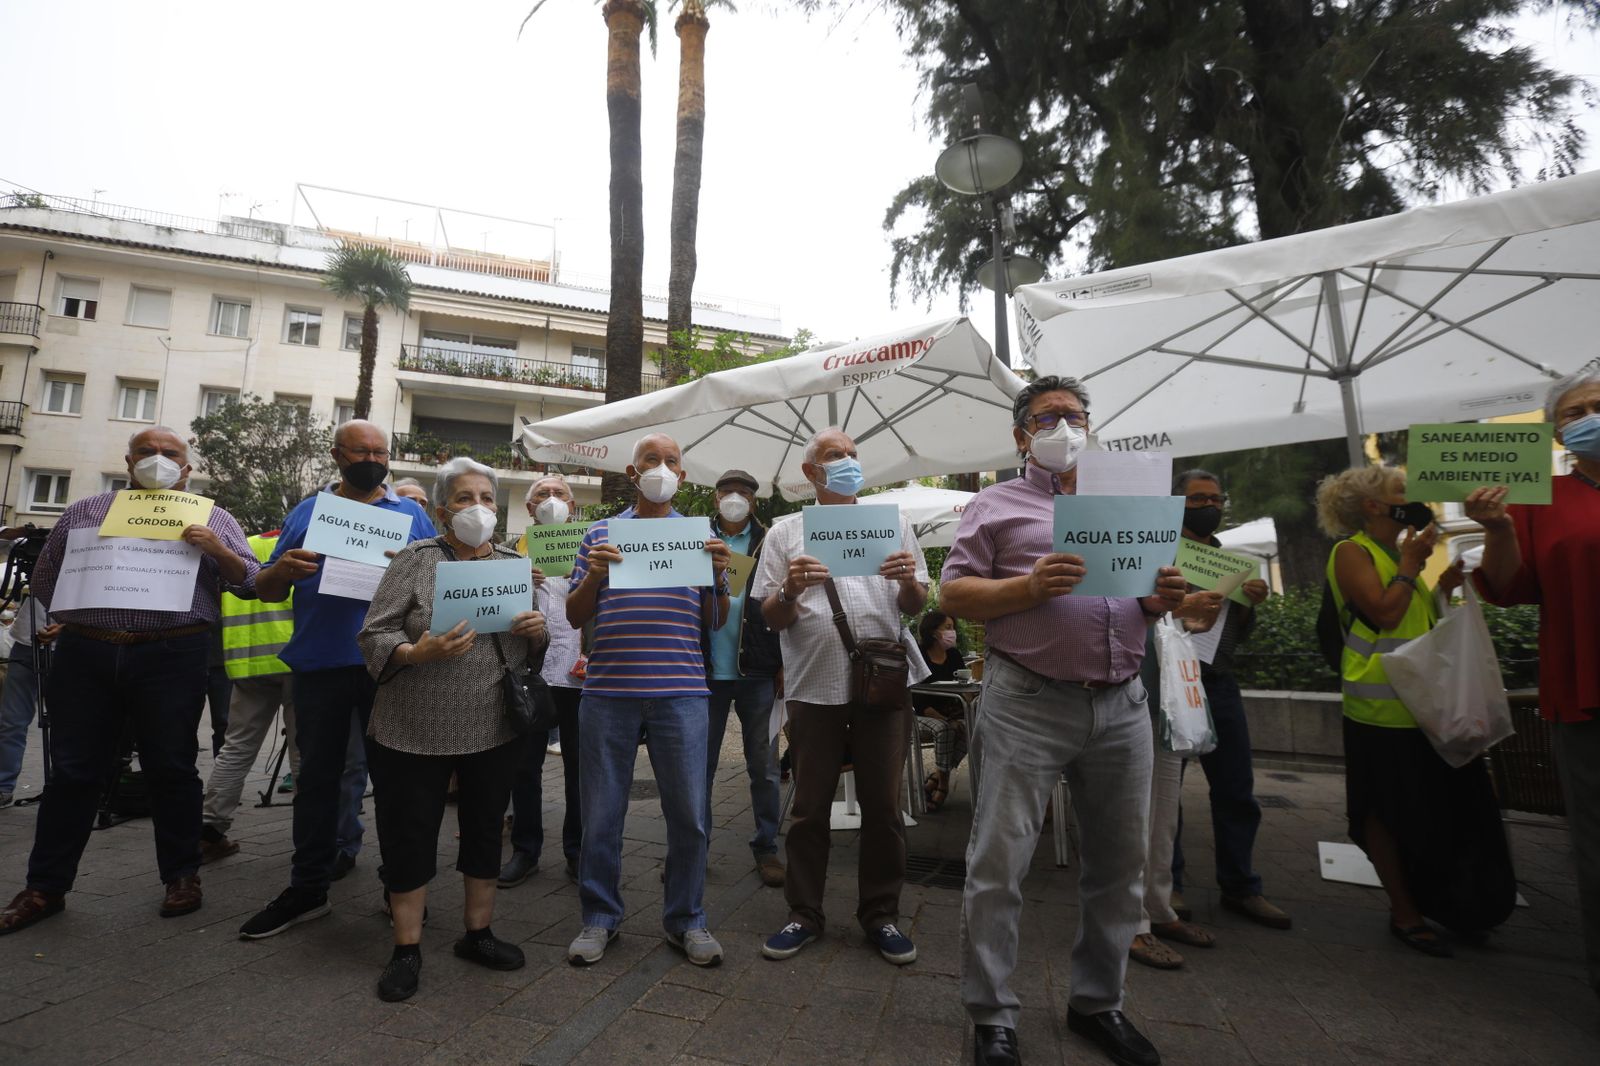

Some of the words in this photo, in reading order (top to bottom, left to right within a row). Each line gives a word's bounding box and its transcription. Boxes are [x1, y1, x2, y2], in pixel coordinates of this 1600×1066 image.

[823, 336, 935, 371] Cruzcampo
[1421, 432, 1540, 444] SANEAMIENTO
[1441, 452, 1458, 462] ES
[1462, 452, 1518, 463] MEDIO
[1418, 471, 1500, 482] AMBIENTE
[1506, 472, 1539, 484] ¡YA!
[145, 494, 199, 506] PERIFERIA
[127, 517, 184, 527] CÓRDOBA
[318, 513, 350, 528] AGUA
[353, 522, 366, 532] ES
[368, 526, 403, 541] SALUD
[533, 528, 588, 539] SANEAMIENT
[810, 531, 842, 541] AGUA
[846, 530, 858, 540] ES
[861, 529, 894, 539] SALUD
[1064, 531, 1112, 544] AGUA
[1117, 531, 1133, 544] ES
[1137, 530, 1177, 544] SALUD
[346, 536, 369, 549] ¡YA!
[545, 543, 555, 551] ES
[558, 542, 582, 550] MEDI
[616, 543, 649, 552] AGUA
[652, 542, 664, 551] ES
[668, 541, 704, 551] SALUD
[843, 548, 865, 559] ¡YA!
[1185, 543, 1252, 568] SANEAMIENTO
[650, 559, 672, 571] ¡YA!
[1111, 557, 1142, 572] ¡YA!
[1182, 561, 1224, 579] AMBIEN
[1208, 560, 1240, 574] MEDIO
[443, 588, 478, 600] AGUA
[482, 587, 494, 597] ES
[496, 584, 528, 596] SALUD
[476, 605, 500, 617] ¡YA!
